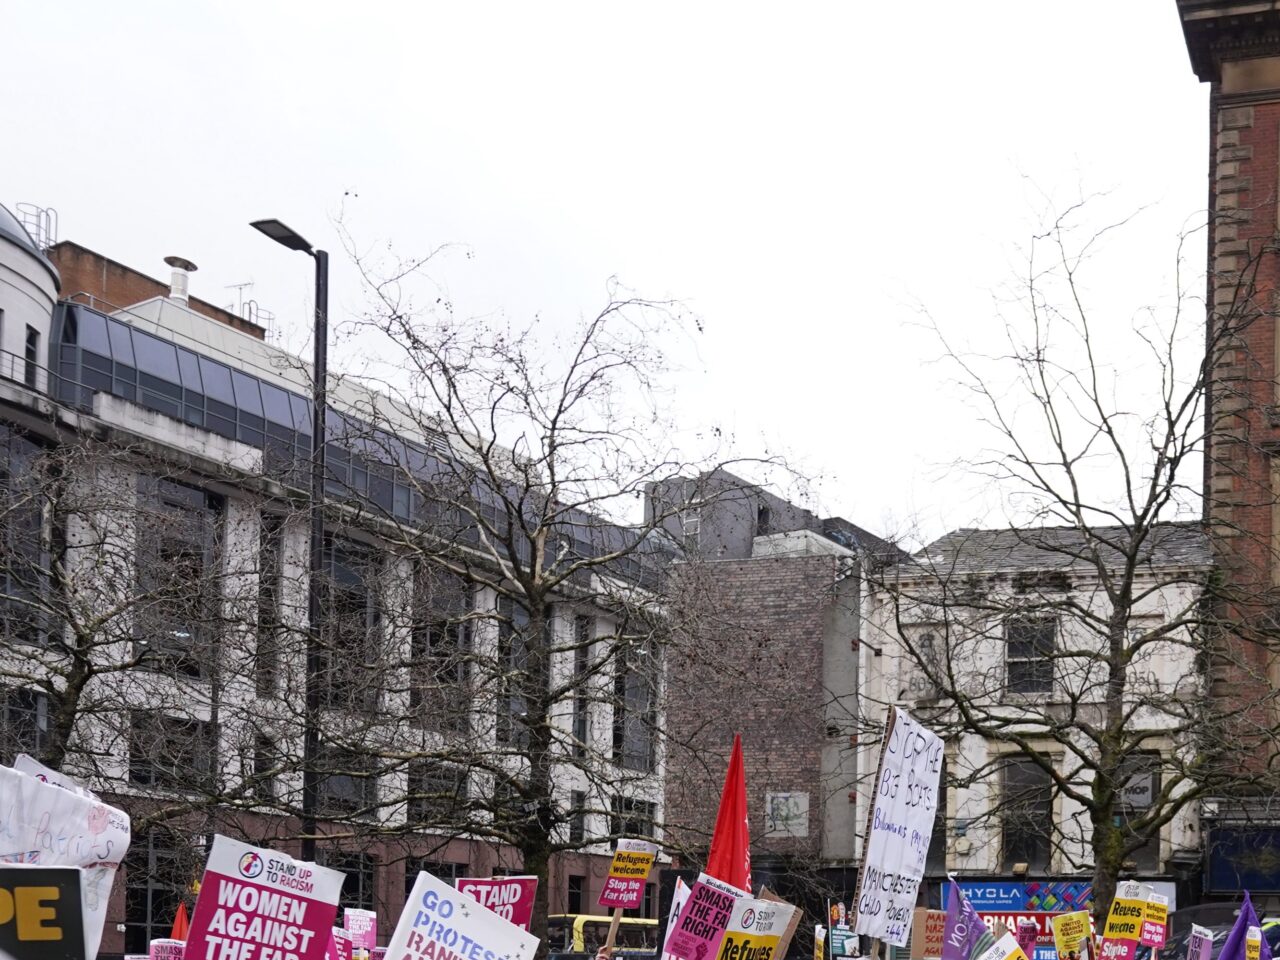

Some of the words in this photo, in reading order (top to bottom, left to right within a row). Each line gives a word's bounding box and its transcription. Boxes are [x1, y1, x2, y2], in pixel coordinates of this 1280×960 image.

[267, 858, 297, 875] STAND
[299, 867, 313, 880] UP
[613, 865, 646, 876] welcome
[616, 853, 651, 867] Refugees
[266, 870, 278, 884] TO
[279, 872, 314, 894] RACISM
[608, 879, 627, 892] Stop
[629, 880, 641, 890] the
[863, 866, 919, 895] MANCHESTER
[216, 879, 308, 925] WOMEN
[422, 890, 454, 919] GO
[462, 883, 522, 907] STAND
[603, 890, 618, 901] far
[619, 891, 638, 902] right
[695, 886, 735, 914] SMASH
[858, 894, 881, 917] CHILD
[689, 900, 713, 922] THE
[207, 908, 315, 954] AGAINST
[681, 915, 720, 942] RIGHT
[154, 945, 183, 957] SMASH
[1039, 950, 1057, 960] THE
